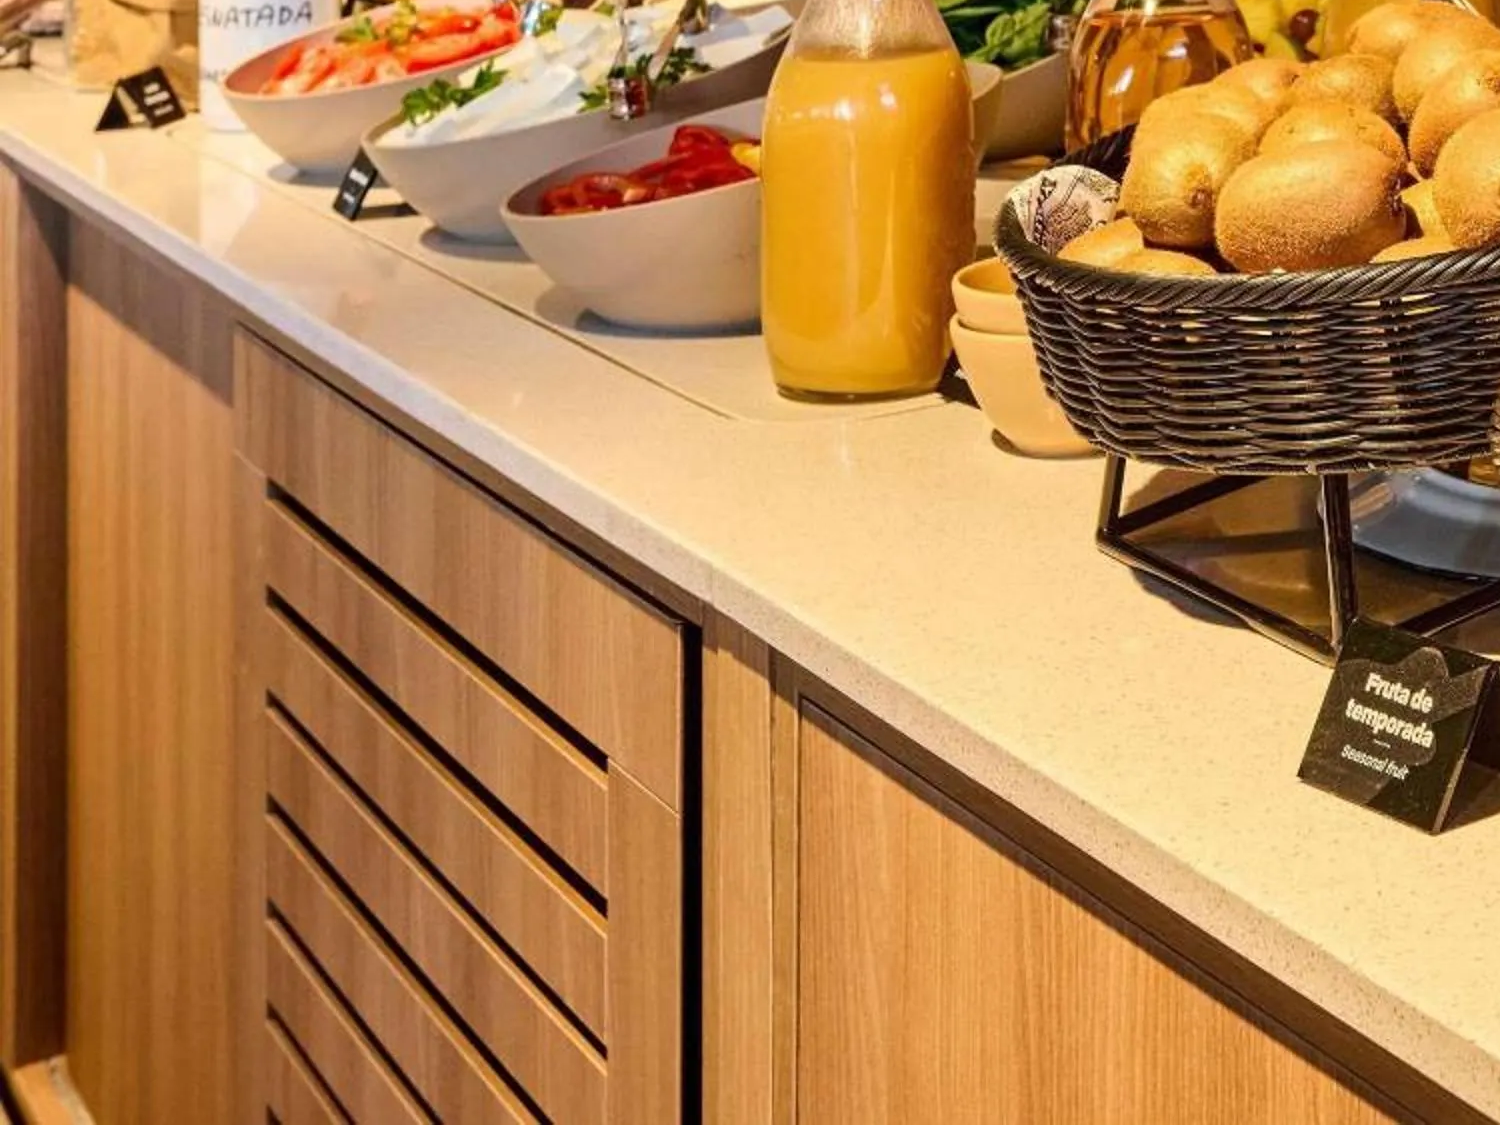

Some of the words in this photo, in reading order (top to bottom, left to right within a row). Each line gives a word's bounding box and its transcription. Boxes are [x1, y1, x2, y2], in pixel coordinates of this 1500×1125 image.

[1365, 672, 1411, 706] Fruta
[1410, 688, 1433, 713] de
[1345, 698, 1434, 748] temporada
[1341, 744, 1388, 772] Seasonal
